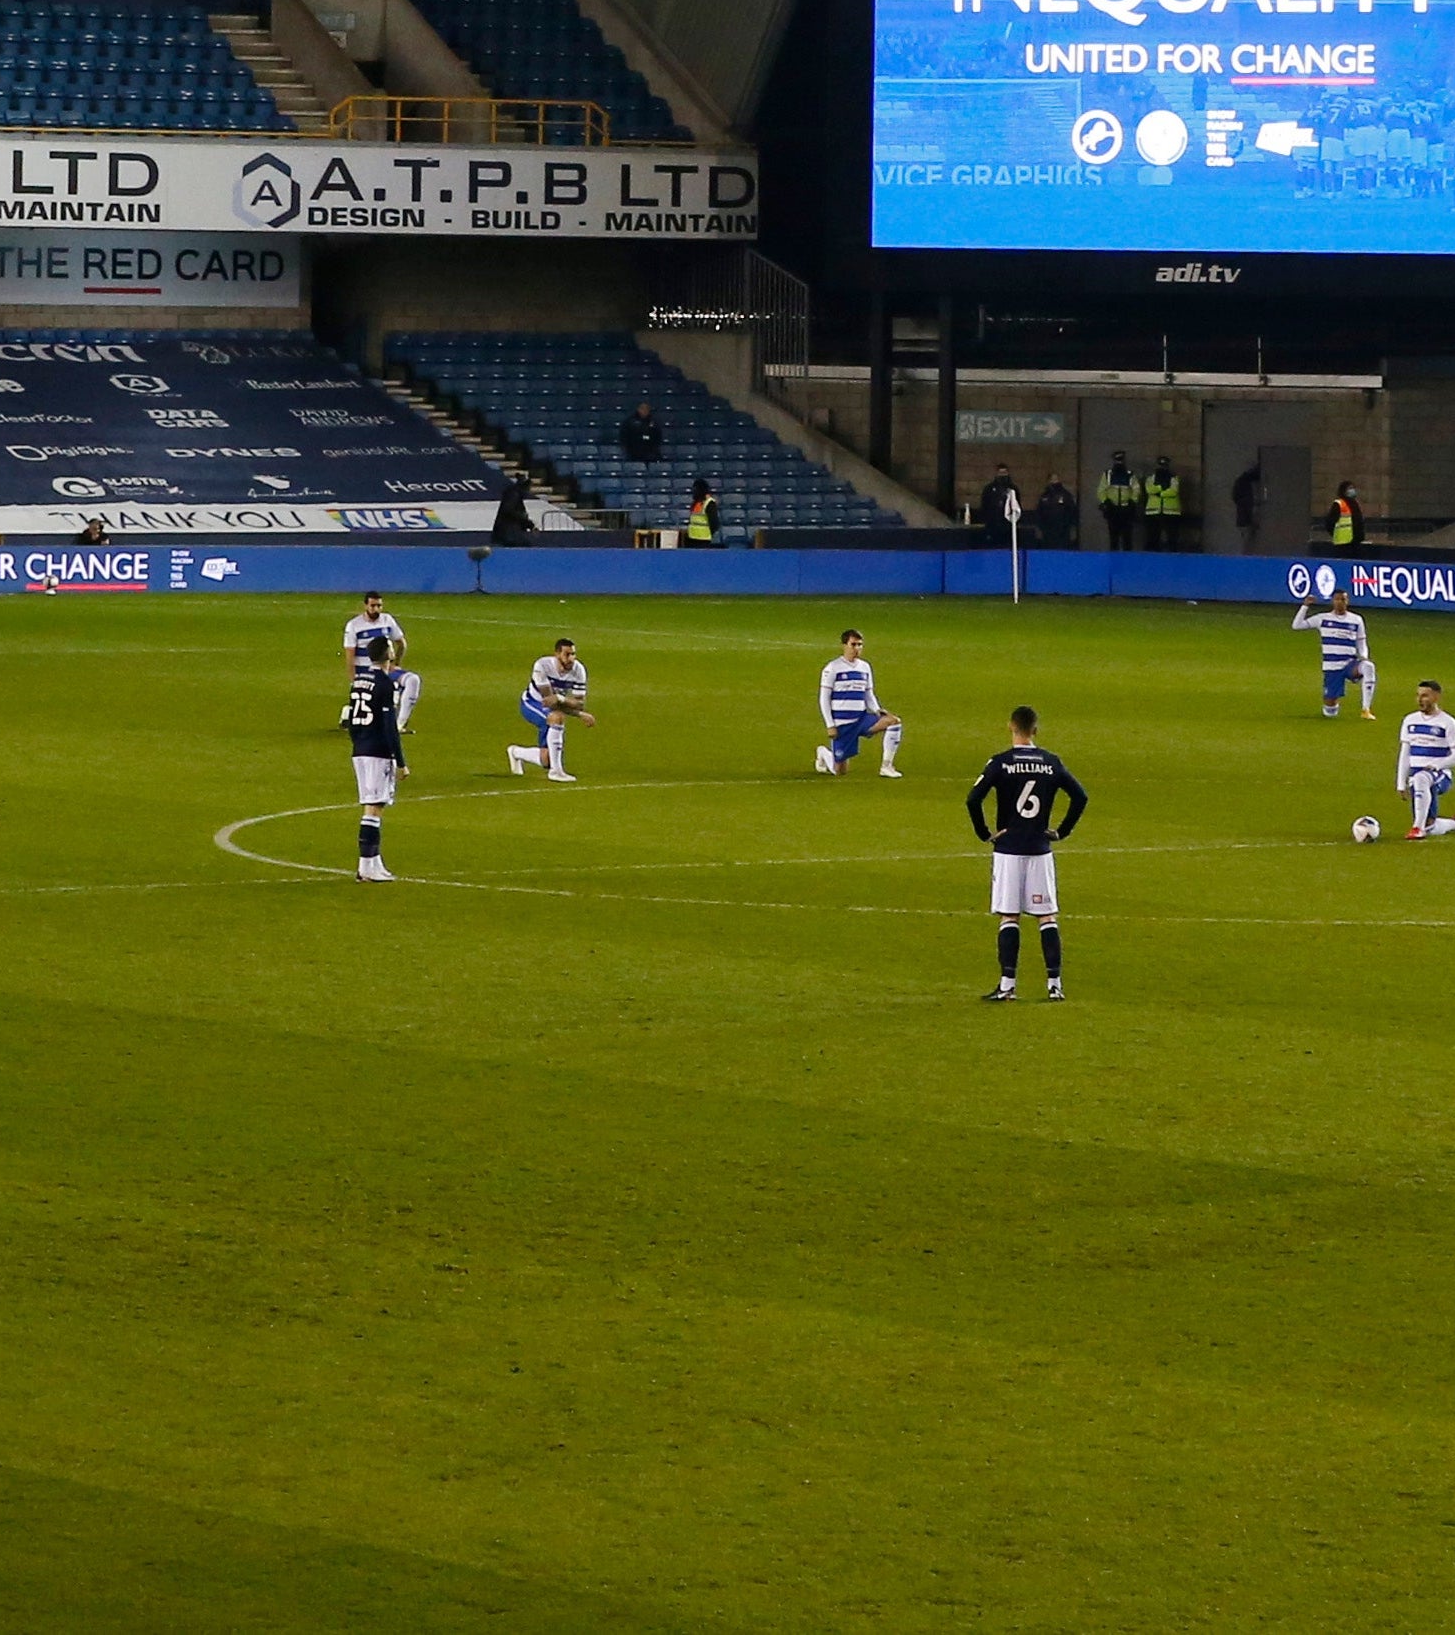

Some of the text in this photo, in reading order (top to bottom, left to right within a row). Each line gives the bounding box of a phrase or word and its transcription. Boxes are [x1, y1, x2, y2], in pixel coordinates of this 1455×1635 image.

[1025, 44, 1376, 75] UNITED FOR CHANGE
[11, 149, 161, 198] LTD
[620, 164, 756, 209] LTD
[307, 206, 425, 228] DESIGN
[471, 210, 561, 230] BUILD
[604, 213, 757, 235] MAINTAIN
[83, 248, 162, 280] RED
[175, 249, 284, 283] CARD
[1155, 264, 1241, 284] adi.tv
[146, 408, 219, 419] DATA
[155, 419, 230, 429] CARS
[976, 415, 1033, 438] EXIT
[165, 447, 302, 458] DYNES
[383, 478, 489, 493] HeronIT
[48, 509, 429, 530] THANK YOU NHS
[24, 552, 149, 581] CHANGE
[350, 691, 374, 726] 25
[1006, 762, 1054, 775] WILLIAMS
[1016, 780, 1041, 819] 6
